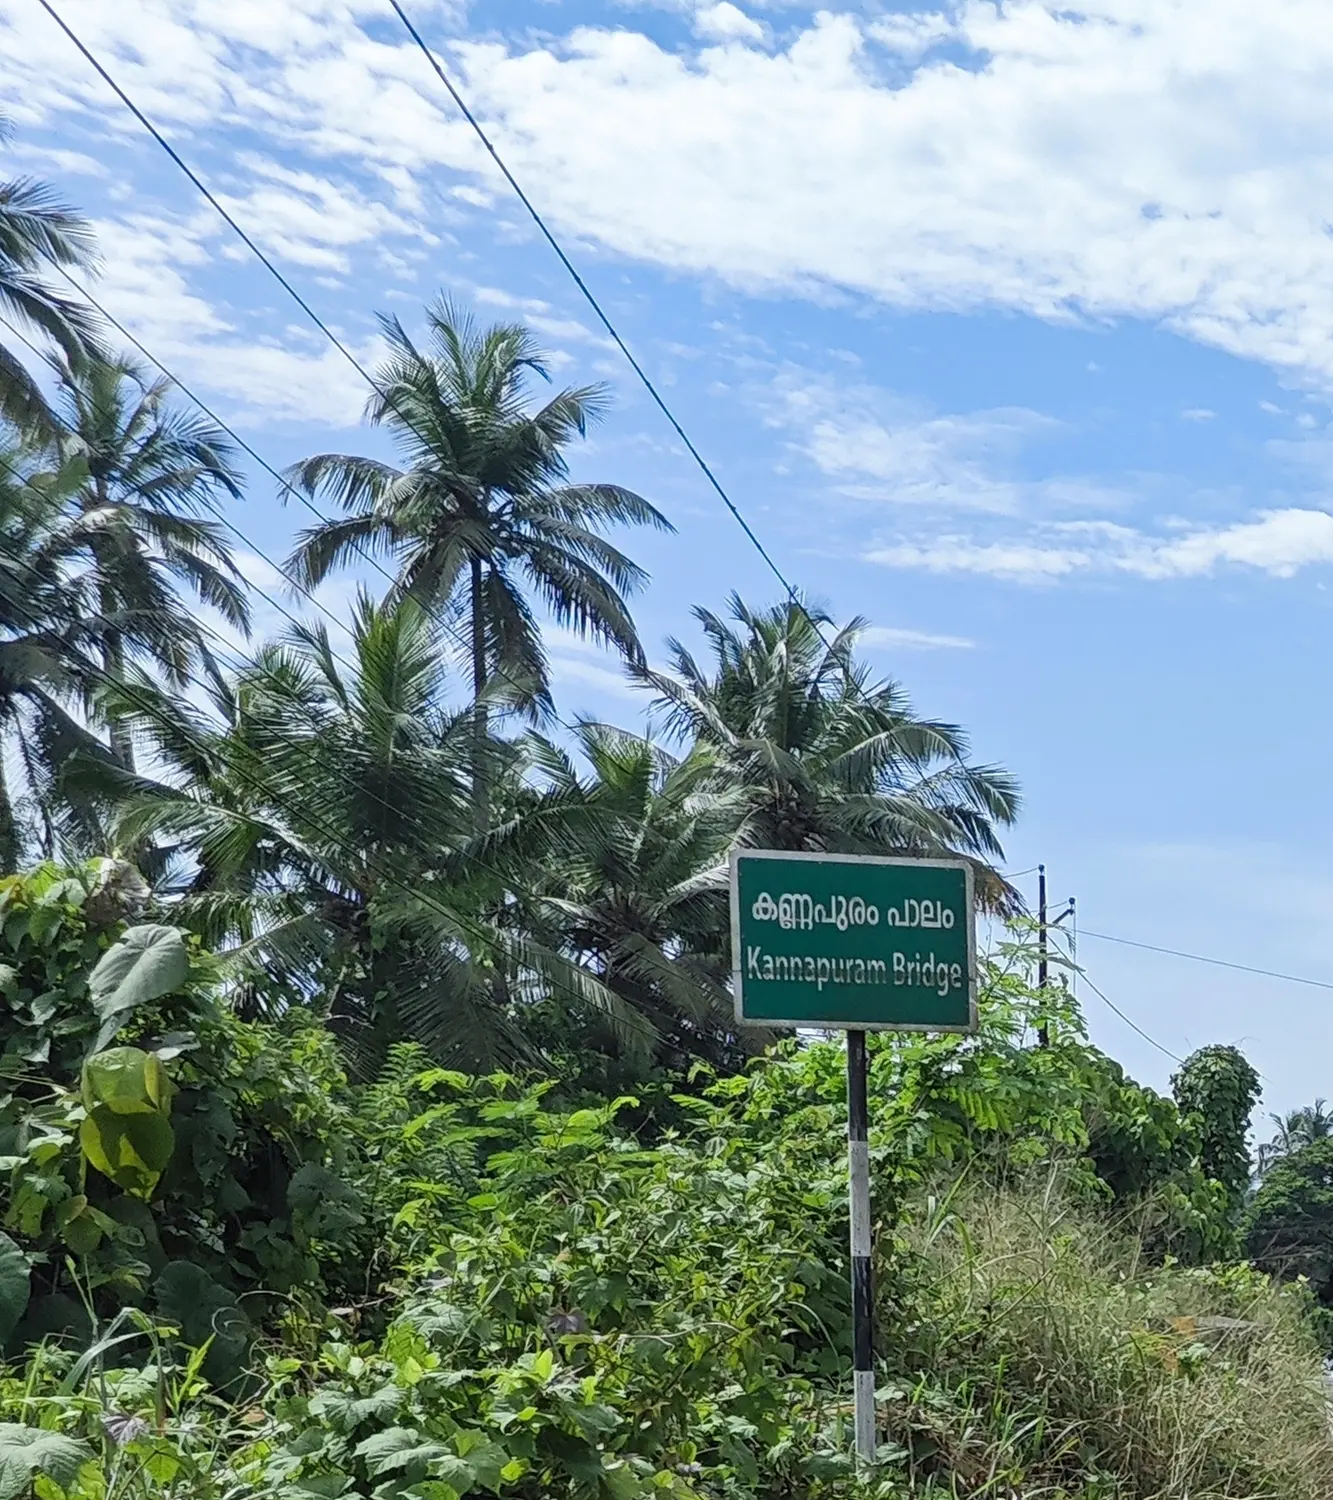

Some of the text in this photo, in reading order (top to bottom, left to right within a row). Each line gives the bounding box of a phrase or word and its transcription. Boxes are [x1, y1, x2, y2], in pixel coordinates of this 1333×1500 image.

[751, 891, 955, 931] കണ്ണപുരം പാലം
[747, 946, 962, 996] Kannapuram Bridge
